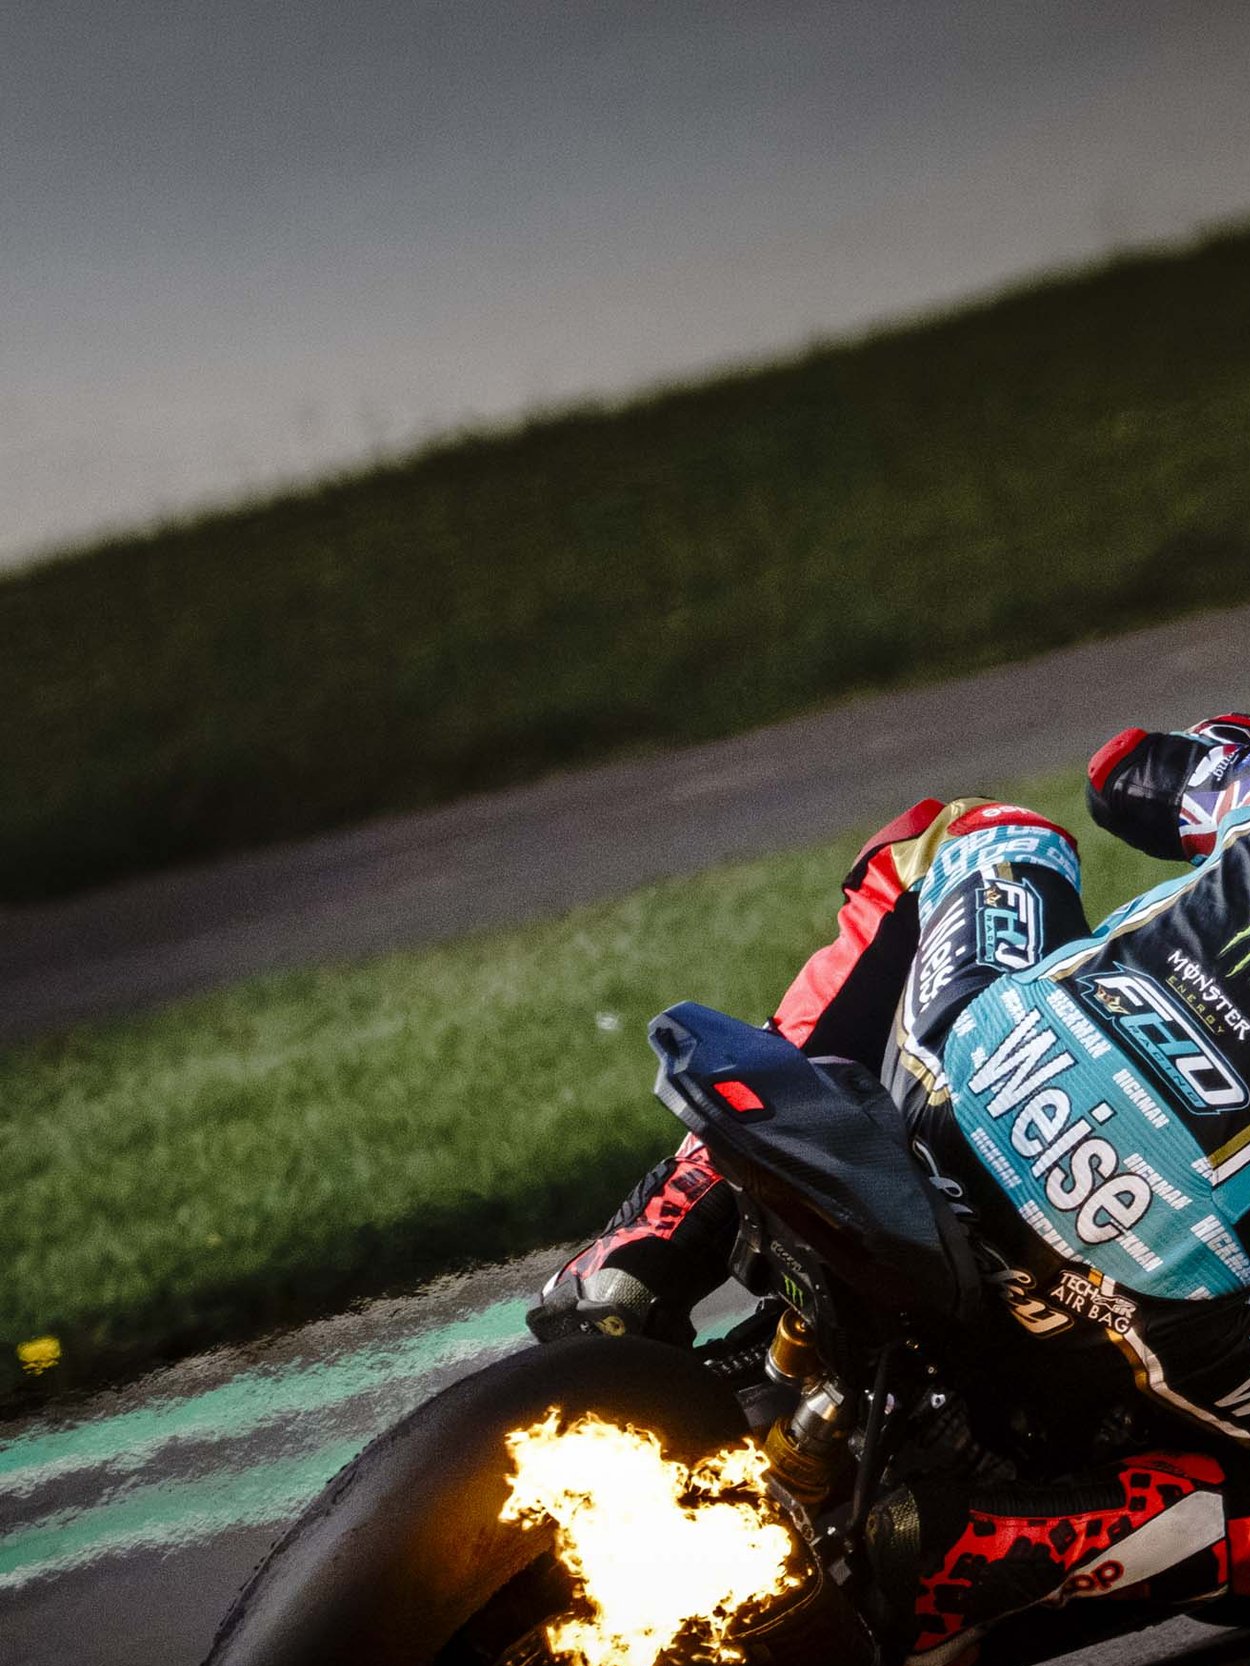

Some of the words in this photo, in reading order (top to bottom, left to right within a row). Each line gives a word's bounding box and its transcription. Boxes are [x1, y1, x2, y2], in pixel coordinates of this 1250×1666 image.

[1046, 988, 1112, 1059] HICKMAN
[1167, 975, 1225, 1035] ENERGY
[1093, 976, 1245, 1105] FHO
[1127, 1024, 1203, 1105] RACING
[968, 1006, 1153, 1245] Weise
[1112, 1068, 1170, 1129] HICKMAN
[1122, 1152, 1193, 1211] HICKMAN
[1050, 1285, 1086, 1313] AIR
[1087, 1305, 1130, 1333] BAG
